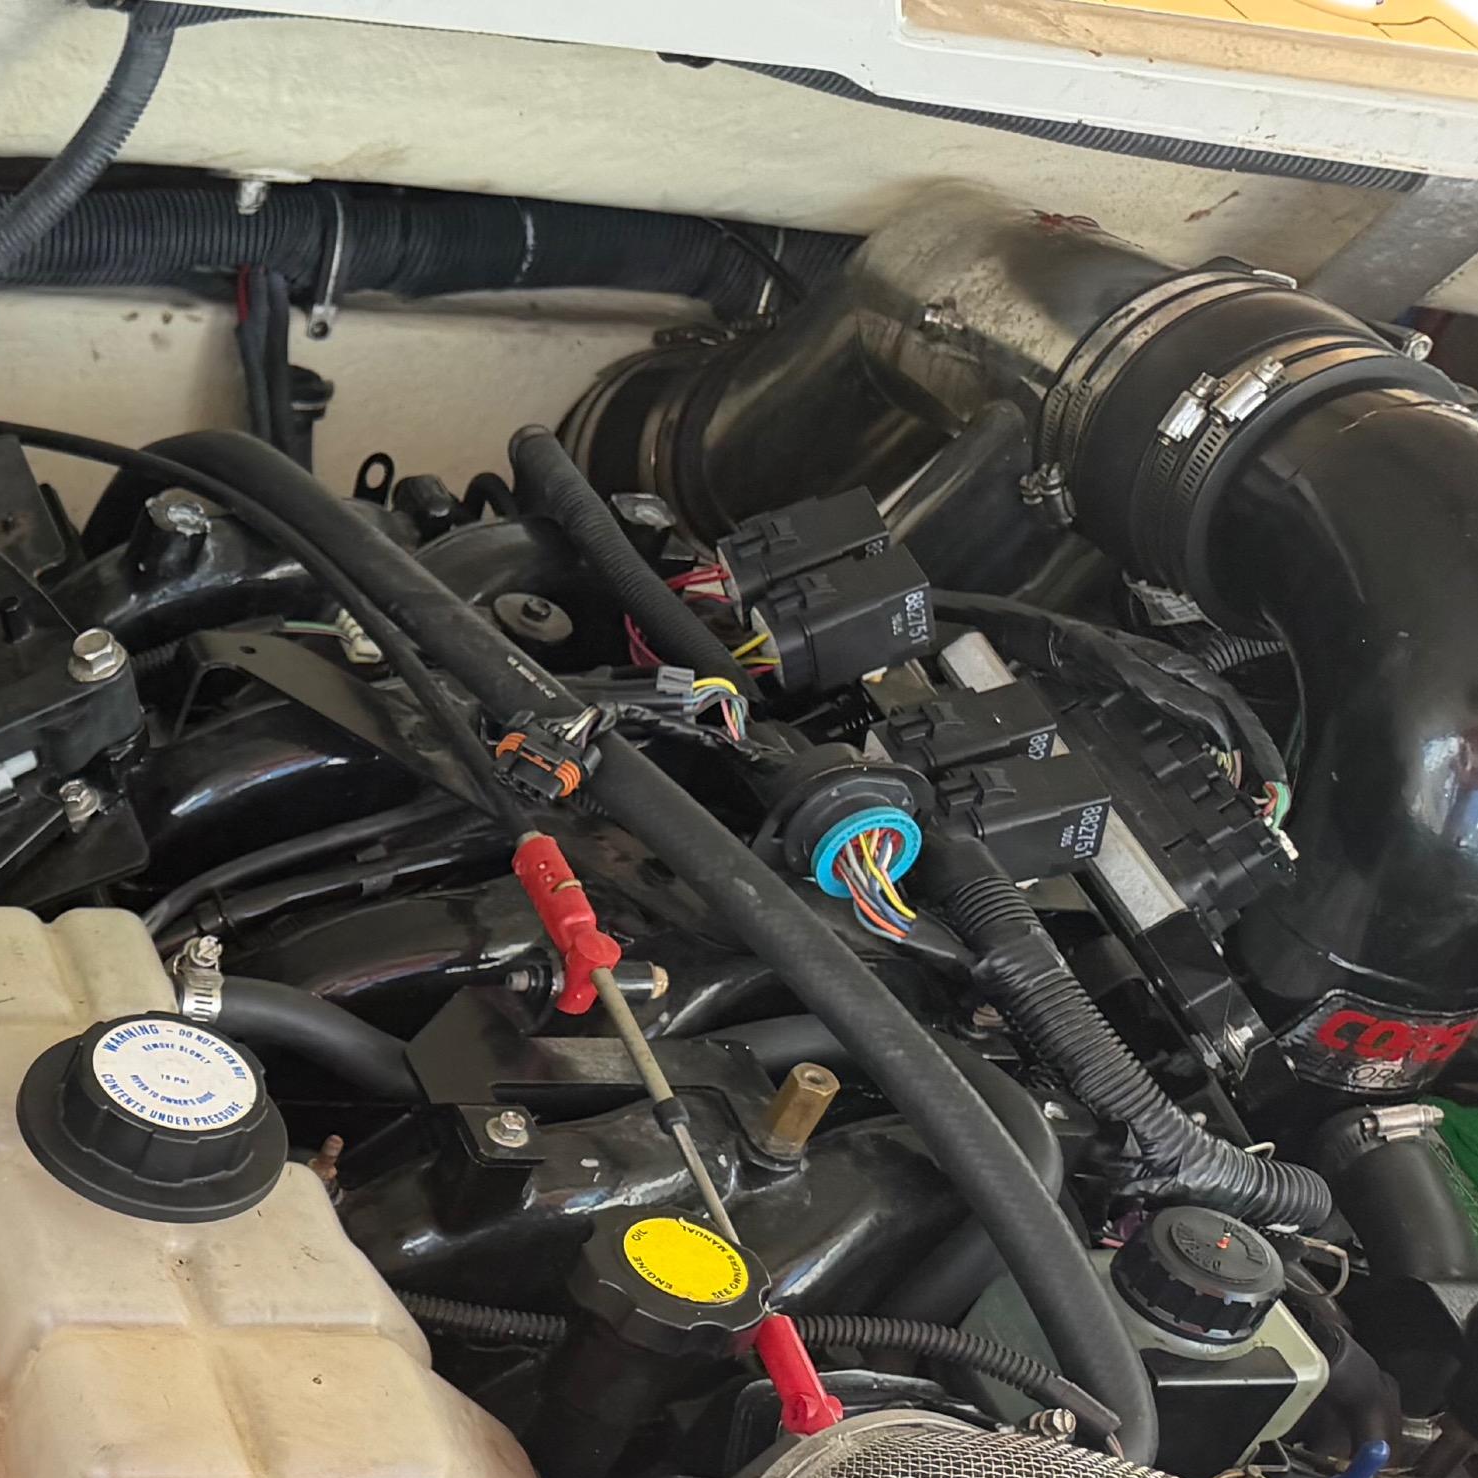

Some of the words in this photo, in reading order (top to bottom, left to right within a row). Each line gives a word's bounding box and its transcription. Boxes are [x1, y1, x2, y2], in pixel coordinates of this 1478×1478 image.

[1073, 805, 1102, 859] 882751
[102, 1024, 159, 1052] WARNING
[179, 1029, 192, 1038] DO
[197, 1035, 216, 1047] NOT
[215, 1046, 237, 1064] OPEN
[101, 1074, 146, 1113] CONTENTS
[150, 1110, 190, 1126] UNDER
[194, 1101, 244, 1126] PRESSURE
[632, 1228, 647, 1241] OIL
[633, 1256, 673, 1289] ENGINE
[712, 1288, 732, 1298] SEE
[727, 1255, 741, 1289] OWNERS
